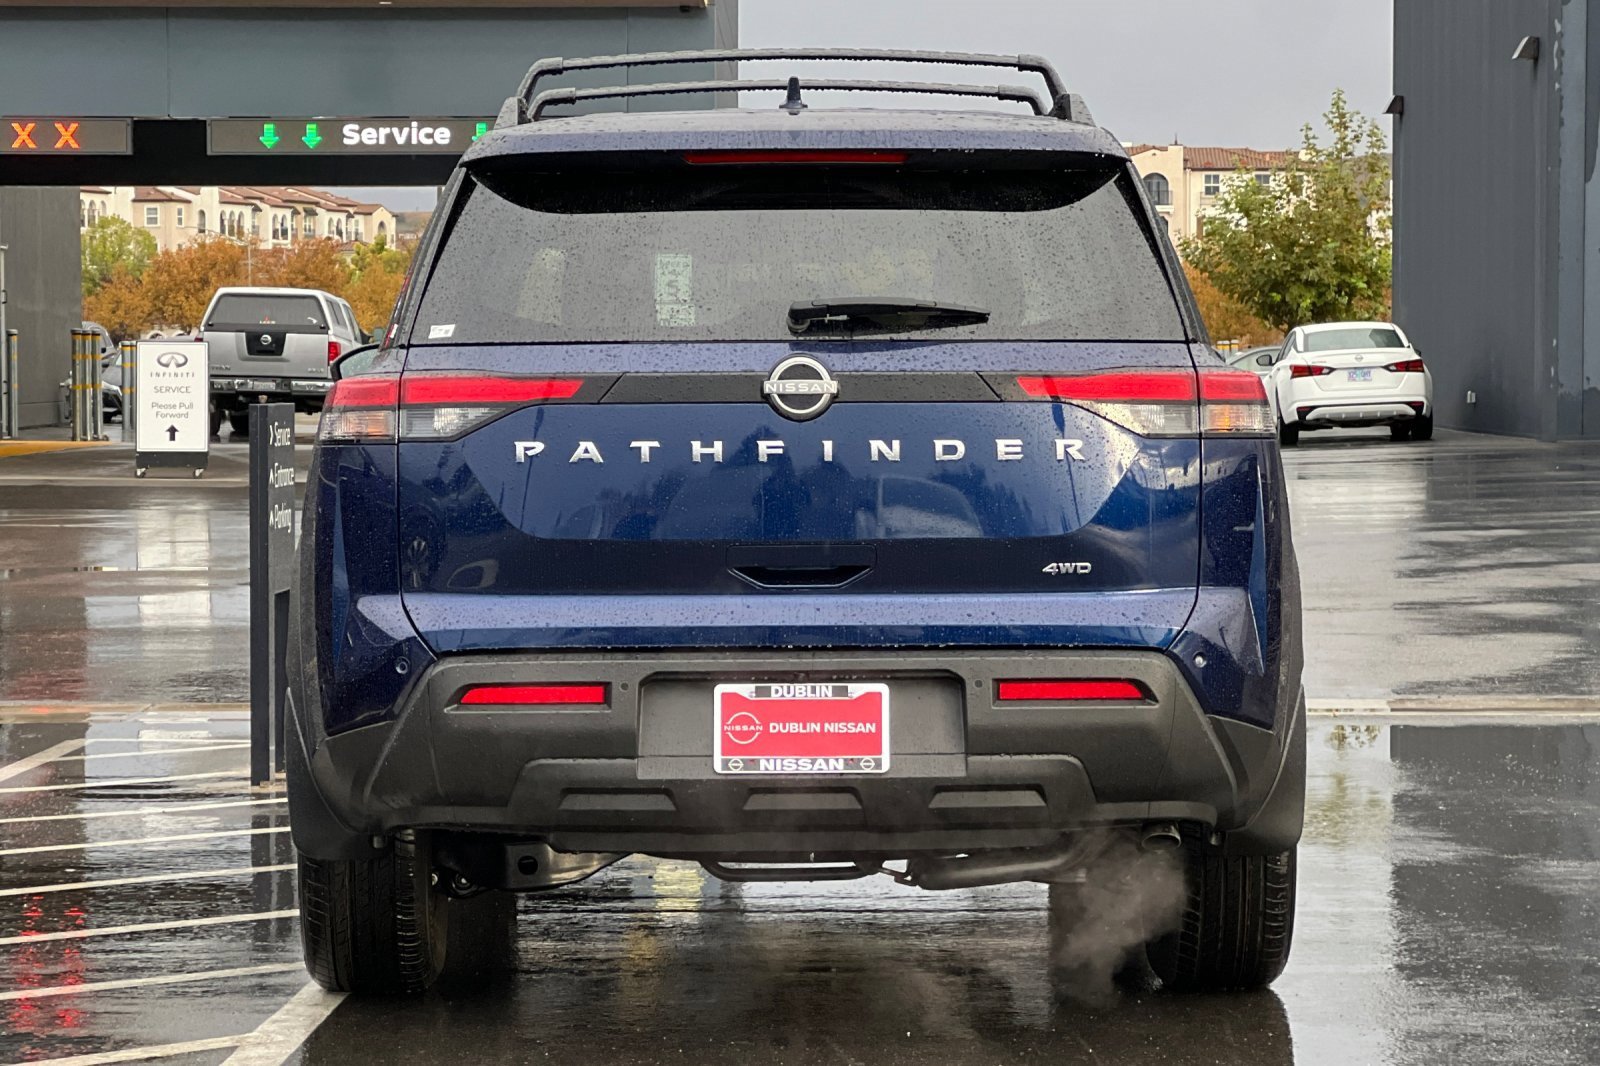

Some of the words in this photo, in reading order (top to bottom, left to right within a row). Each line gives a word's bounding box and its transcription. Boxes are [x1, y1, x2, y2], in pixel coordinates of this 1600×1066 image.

[342, 121, 451, 146] Service
[153, 385, 192, 394] SERVICE
[765, 382, 835, 393] NISSAN
[151, 402, 177, 410] Please
[179, 402, 194, 410] Pull
[155, 411, 189, 419] Forward
[274, 421, 291, 447] Service
[514, 439, 1086, 463] PATHFINDER
[274, 462, 295, 488] Entrance
[274, 502, 292, 533] Parking
[1042, 562, 1092, 576] 4WD
[770, 685, 833, 698] DUBLIN
[769, 722, 821, 733] DUBLIN
[824, 722, 877, 733] NISSAN
[759, 758, 844, 771] NISSAN
